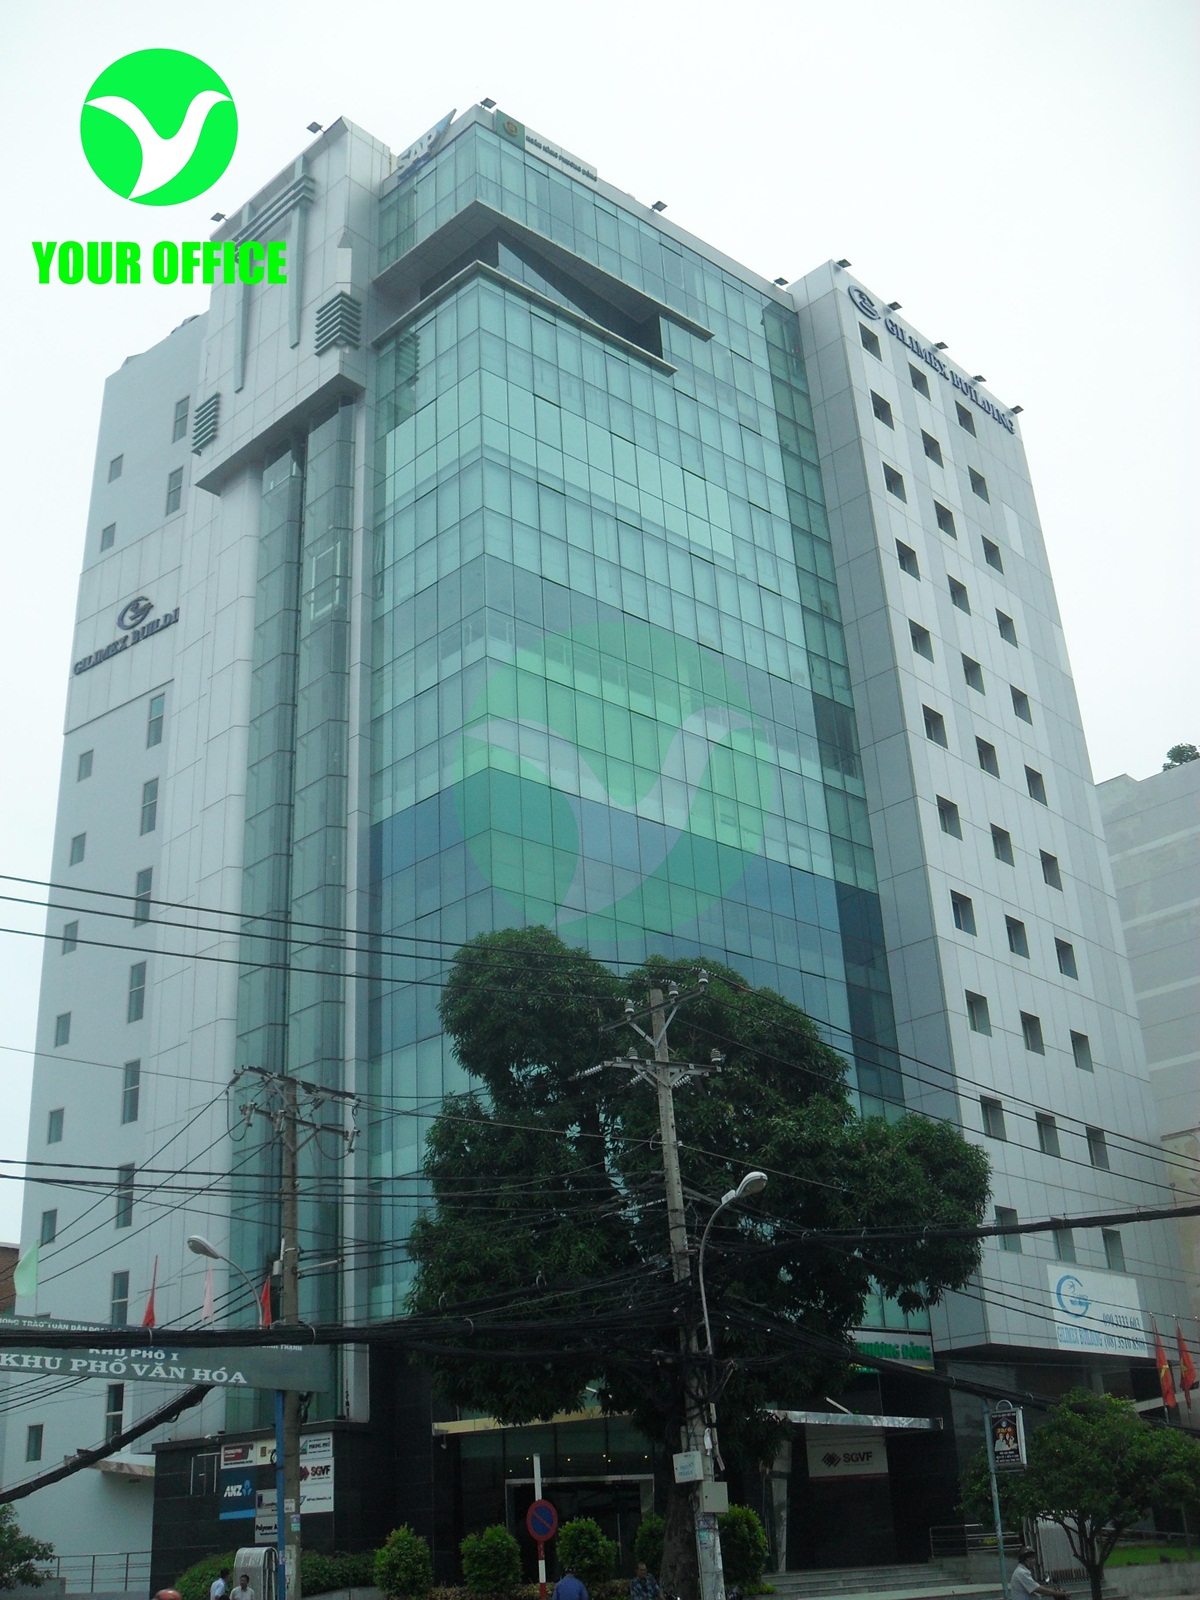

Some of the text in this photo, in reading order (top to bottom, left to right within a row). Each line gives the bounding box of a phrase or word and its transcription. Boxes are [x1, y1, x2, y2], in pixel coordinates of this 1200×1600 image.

[884, 317, 1016, 434] GILIMEX BUILDING
[73, 634, 130, 676] GILIMEX
[0, 1352, 248, 1384] KHU PHỐ VĂN HÓA
[842, 1451, 873, 1463] SGVF
[310, 1465, 331, 1477] SGVF
[223, 1484, 243, 1498] ANZ
